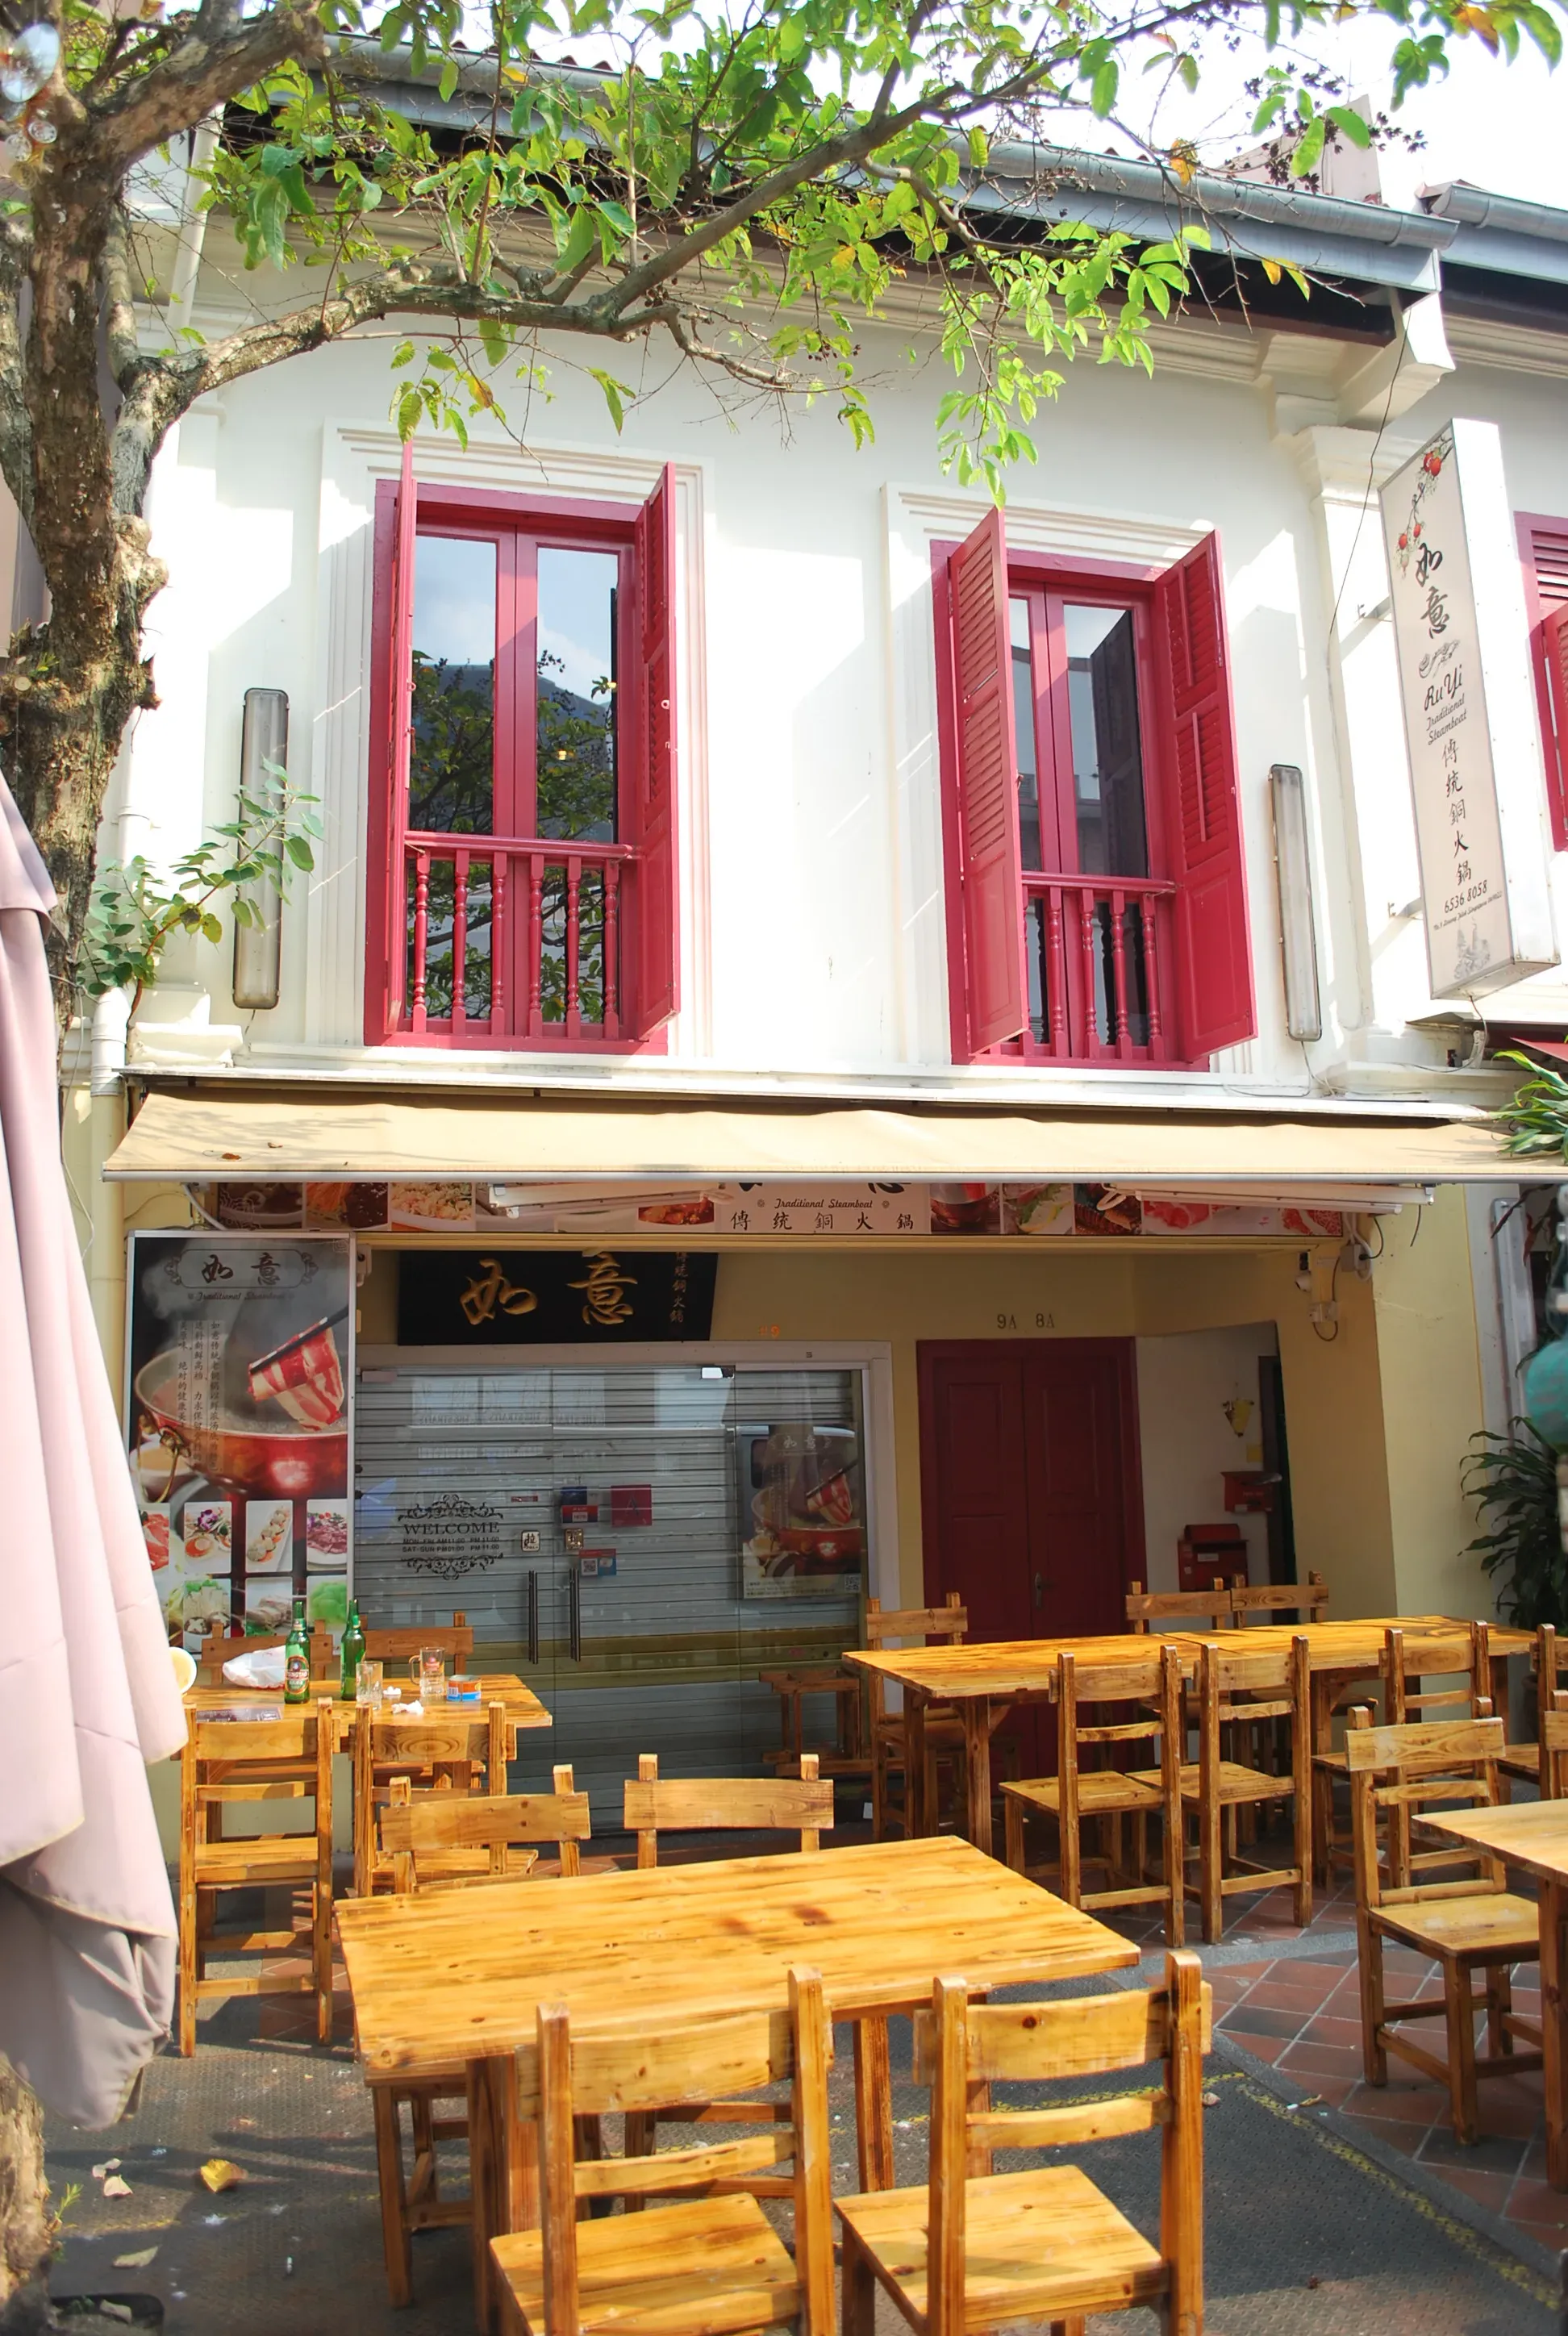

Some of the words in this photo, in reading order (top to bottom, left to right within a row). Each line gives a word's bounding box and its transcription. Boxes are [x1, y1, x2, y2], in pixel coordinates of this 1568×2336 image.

[1416, 542, 1449, 639] 如意
[1426, 693, 1464, 731] Traditional
[1428, 709, 1466, 745] Steamboat
[1445, 892, 1464, 913] 6536
[1467, 880, 1487, 902] 8058
[774, 1199, 824, 1208] Traditional
[828, 1199, 873, 1208] Steamboat
[202, 1253, 281, 1286] 如意
[460, 1253, 638, 1325] 如意
[997, 1313, 1016, 1329] 9A
[1036, 1312, 1055, 1329] 8A
[403, 1521, 500, 1534] WELCOME
